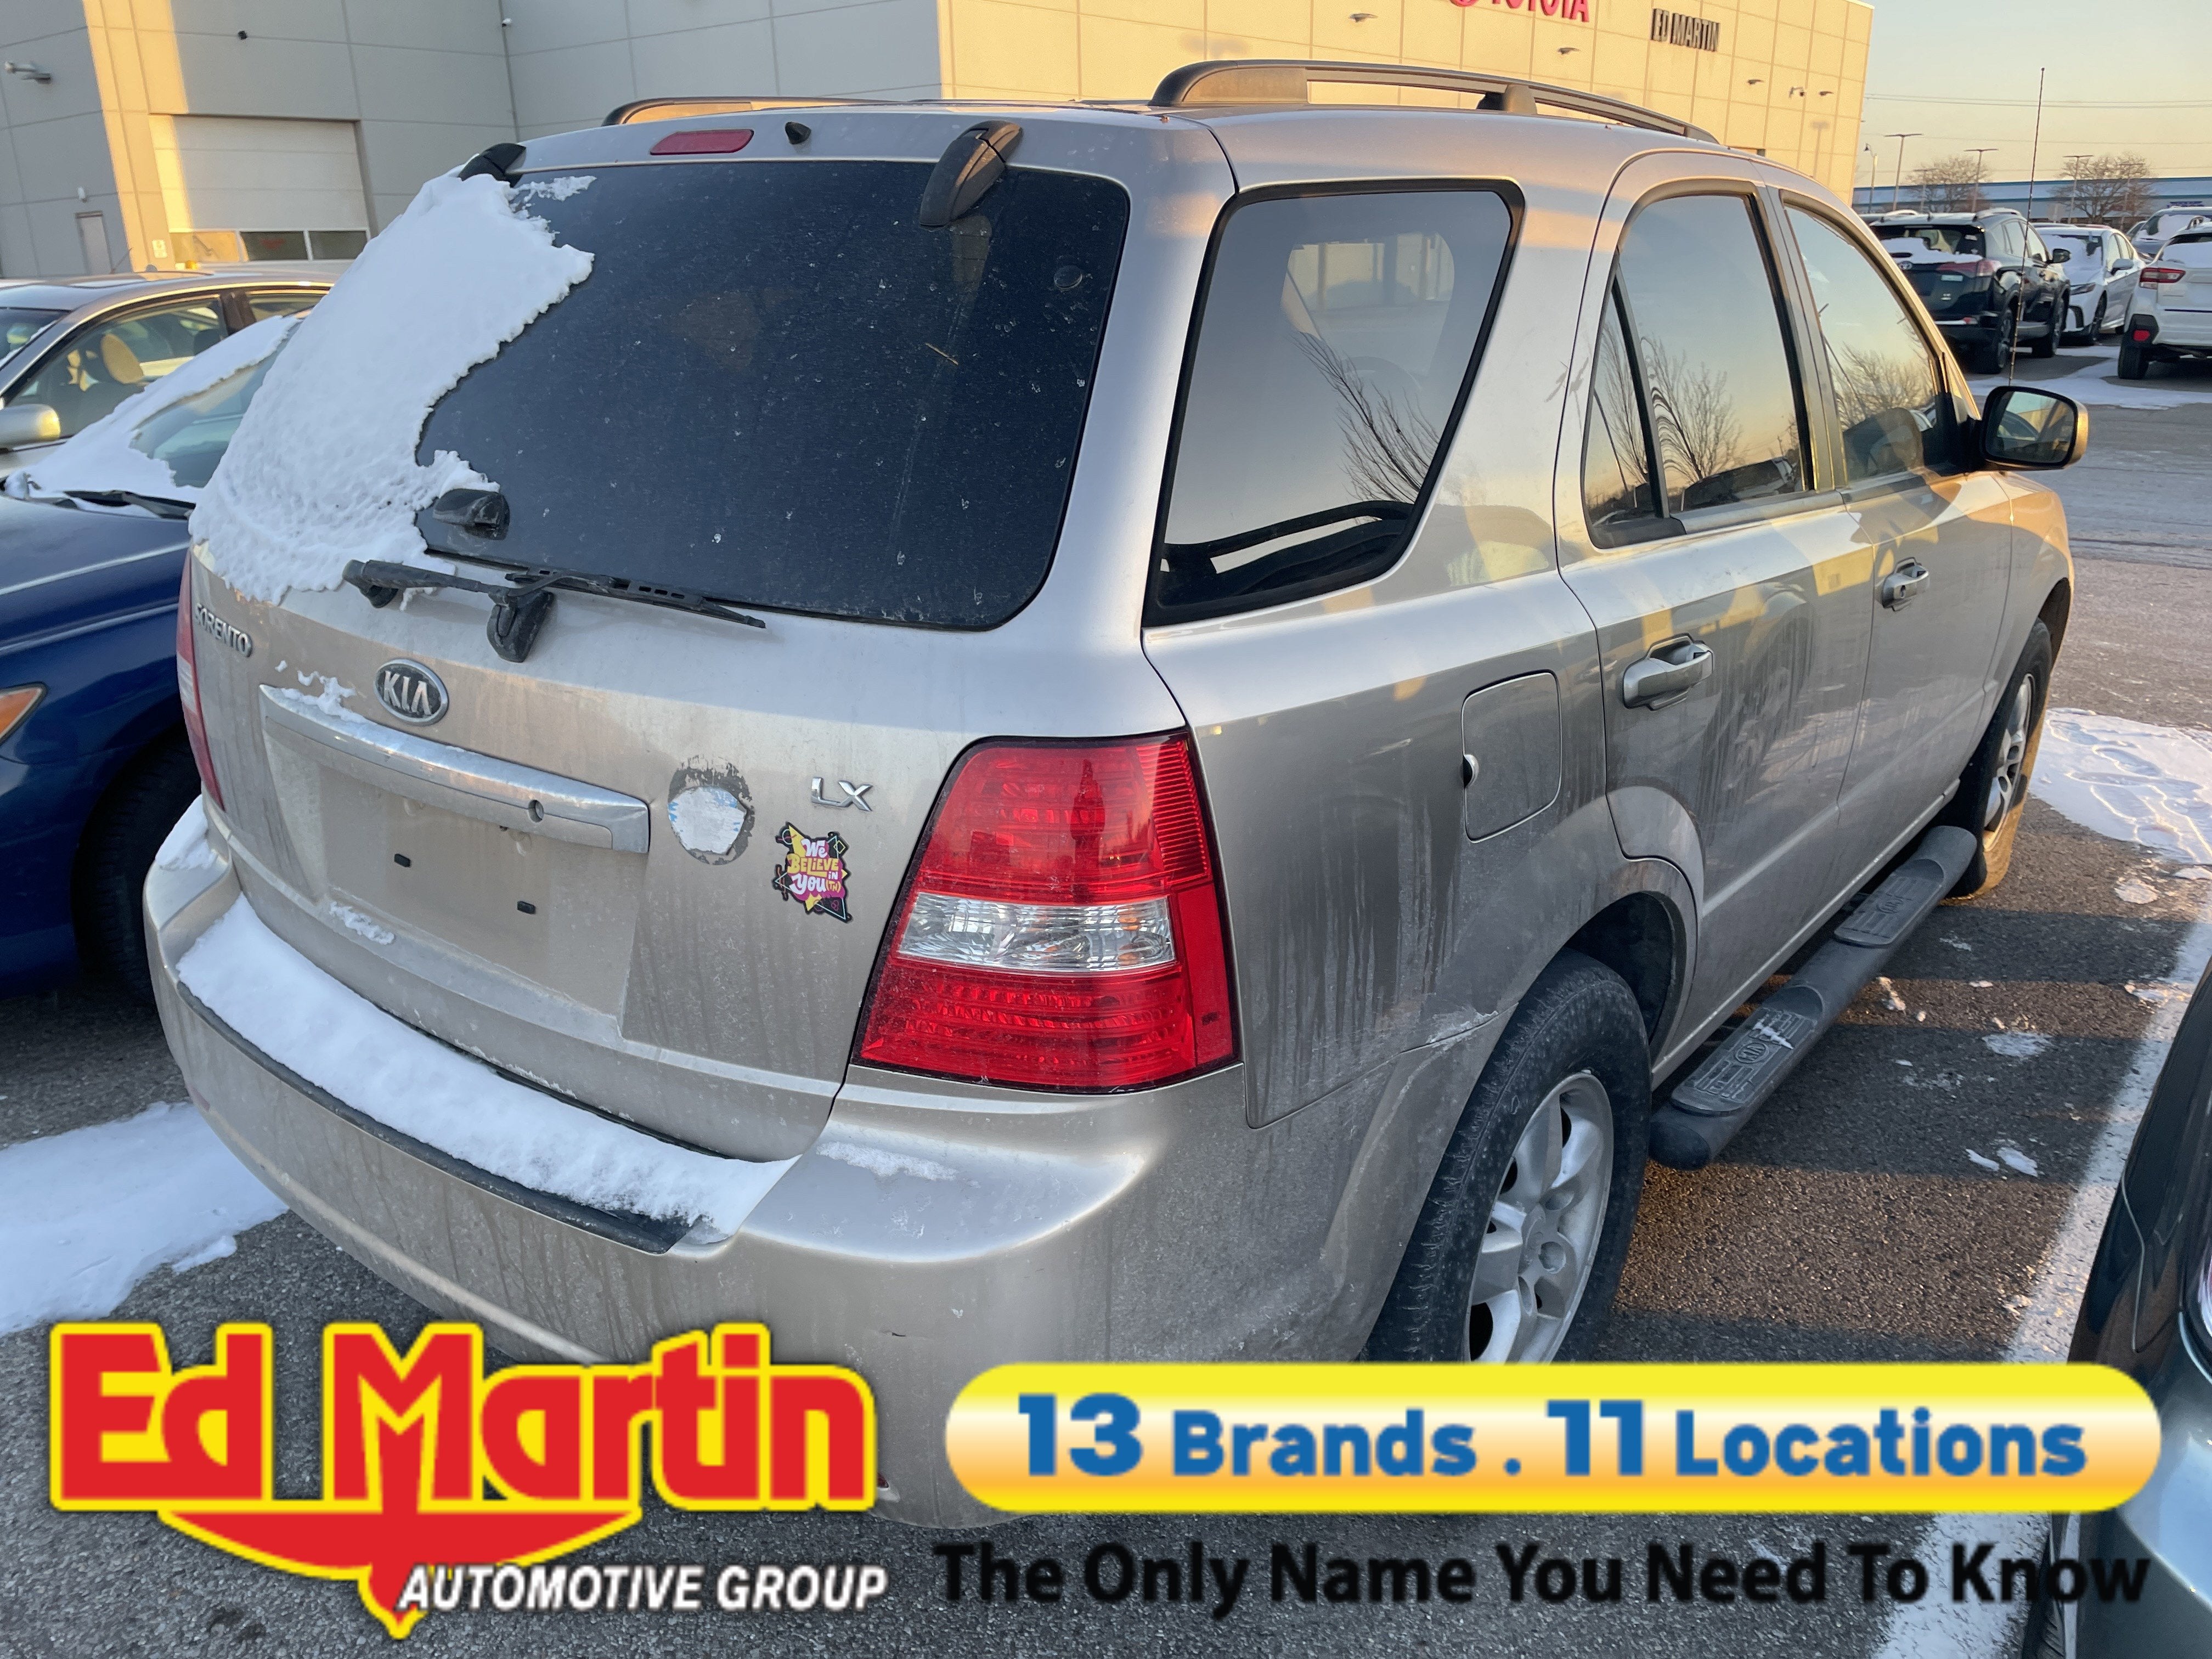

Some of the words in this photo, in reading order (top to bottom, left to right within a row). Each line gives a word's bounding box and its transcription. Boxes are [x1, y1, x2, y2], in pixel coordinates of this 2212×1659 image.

[1651, 8, 1669, 42] ED
[1670, 13, 1720, 52] MARTIN
[194, 603, 253, 657] SORENTO
[383, 670, 432, 715] KIA
[811, 776, 873, 812] LX
[800, 838, 828, 858] We
